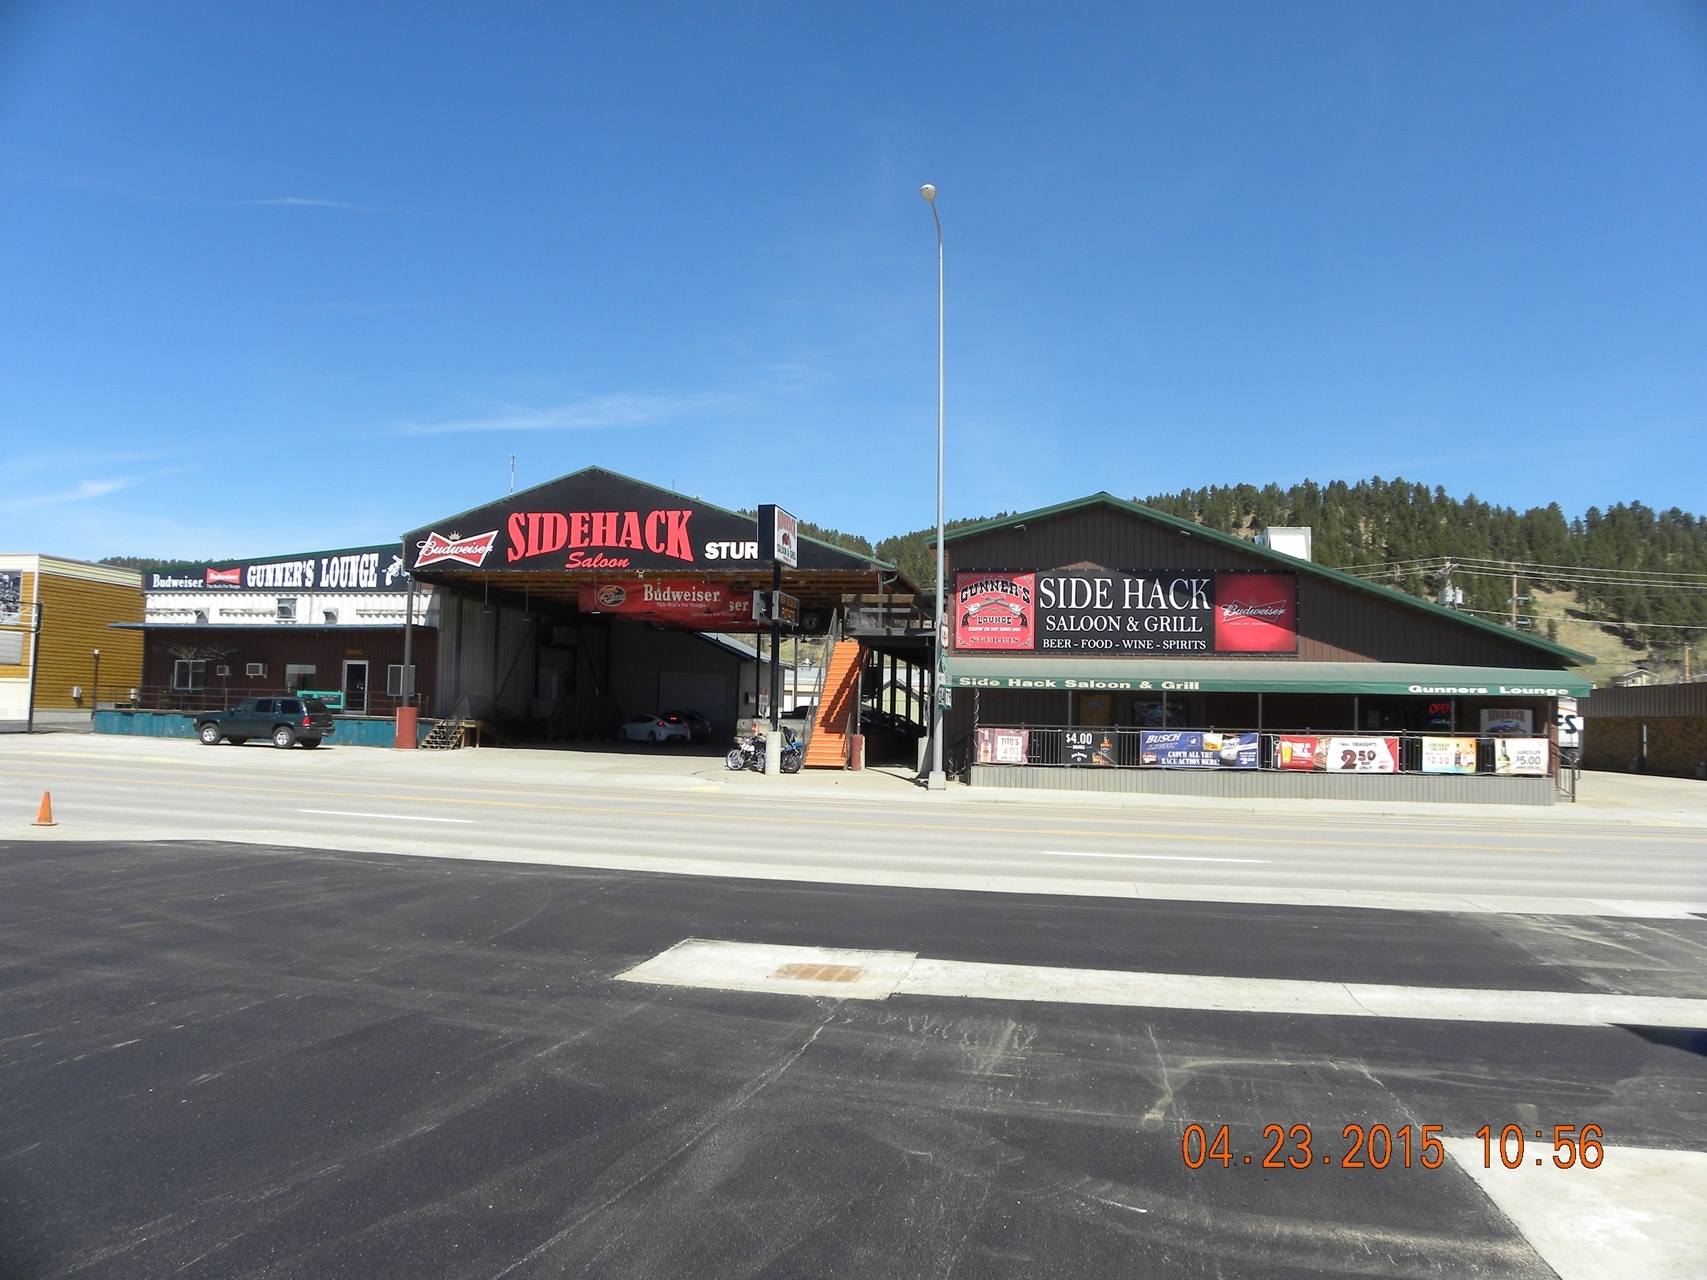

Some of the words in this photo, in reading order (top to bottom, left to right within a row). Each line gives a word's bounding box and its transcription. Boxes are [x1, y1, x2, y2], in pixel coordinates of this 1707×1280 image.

[507, 510, 695, 562] SIDEHACK
[416, 539, 495, 557] Budweiser
[564, 551, 631, 569] Saloon
[247, 559, 315, 588] GUNNER'S
[320, 553, 380, 589] LOUNGE
[960, 579, 1032, 605] GUNNER'S
[1040, 577, 1114, 611] SIDE
[1122, 577, 1211, 611] HACK
[1221, 604, 1286, 618] Budweiser
[977, 616, 1013, 625] LOUNGE
[1046, 615, 1121, 633] SALOON
[1127, 615, 1140, 633] &
[1144, 615, 1204, 633] GRILL
[970, 636, 1020, 644] STURGIS
[1043, 639, 1072, 650] BEER
[1081, 639, 1113, 650] FOOD
[1122, 640, 1153, 650] WINE
[1162, 640, 1207, 650] SPIRITS
[959, 677, 1002, 687] Side
[1008, 678, 1058, 688] Hack
[1064, 679, 1131, 689] Saloon
[1139, 680, 1154, 689] &
[1161, 680, 1200, 690] Grill
[1408, 685, 1488, 694] Gunners
[1499, 686, 1569, 697] Lounge
[1001, 737, 1020, 746] TITO'S
[1065, 732, 1093, 745] $4.00
[1146, 733, 1182, 744] BUSCH
[1190, 751, 1200, 759] ALL
[1516, 755, 1542, 765] $5.00
